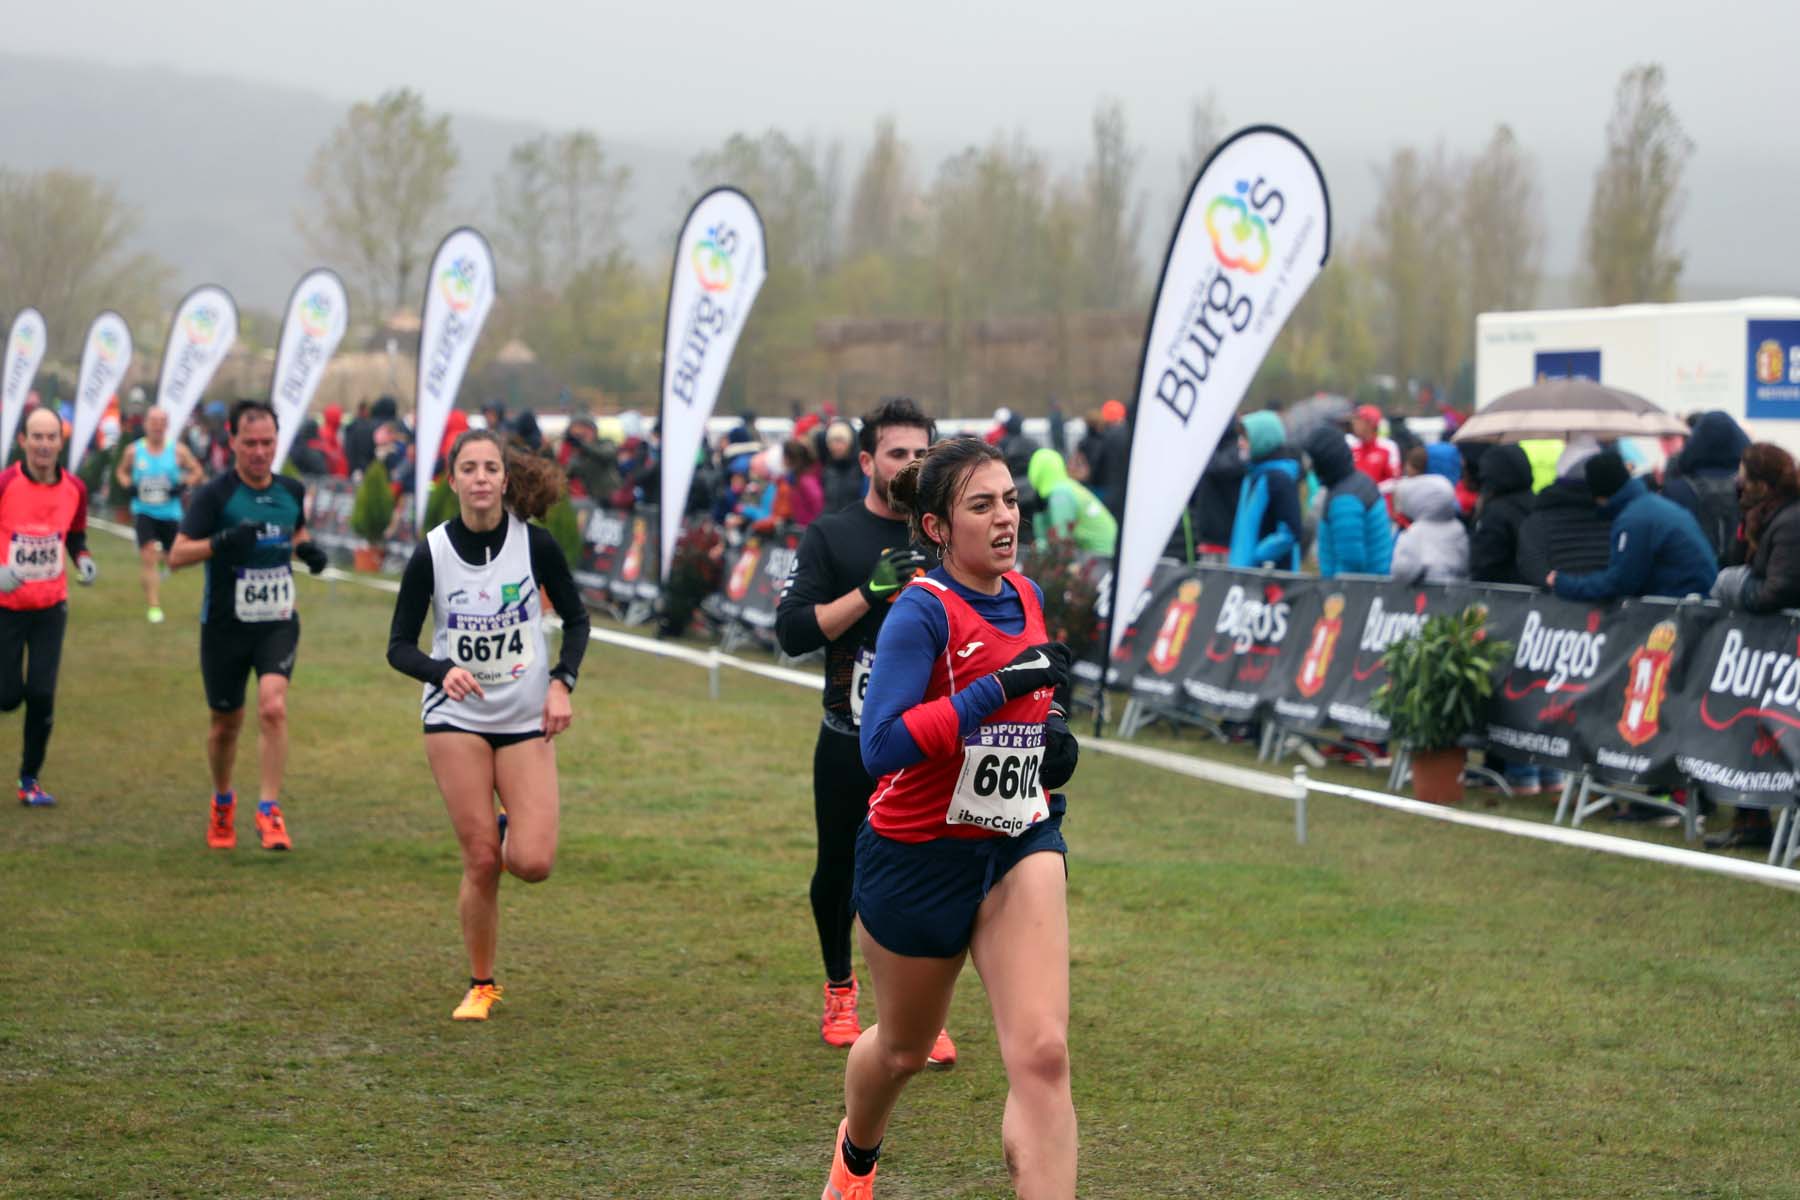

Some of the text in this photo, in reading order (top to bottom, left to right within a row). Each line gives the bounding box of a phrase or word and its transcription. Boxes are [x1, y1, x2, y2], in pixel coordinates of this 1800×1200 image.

[244, 582, 289, 605] 6411
[457, 616, 519, 631] BURGOS
[457, 628, 524, 662] 6674
[1514, 610, 1606, 693] Burgos
[981, 735, 1041, 747] BURGOS
[973, 753, 1038, 800] 6602
[958, 809, 1023, 833] iberCaja
